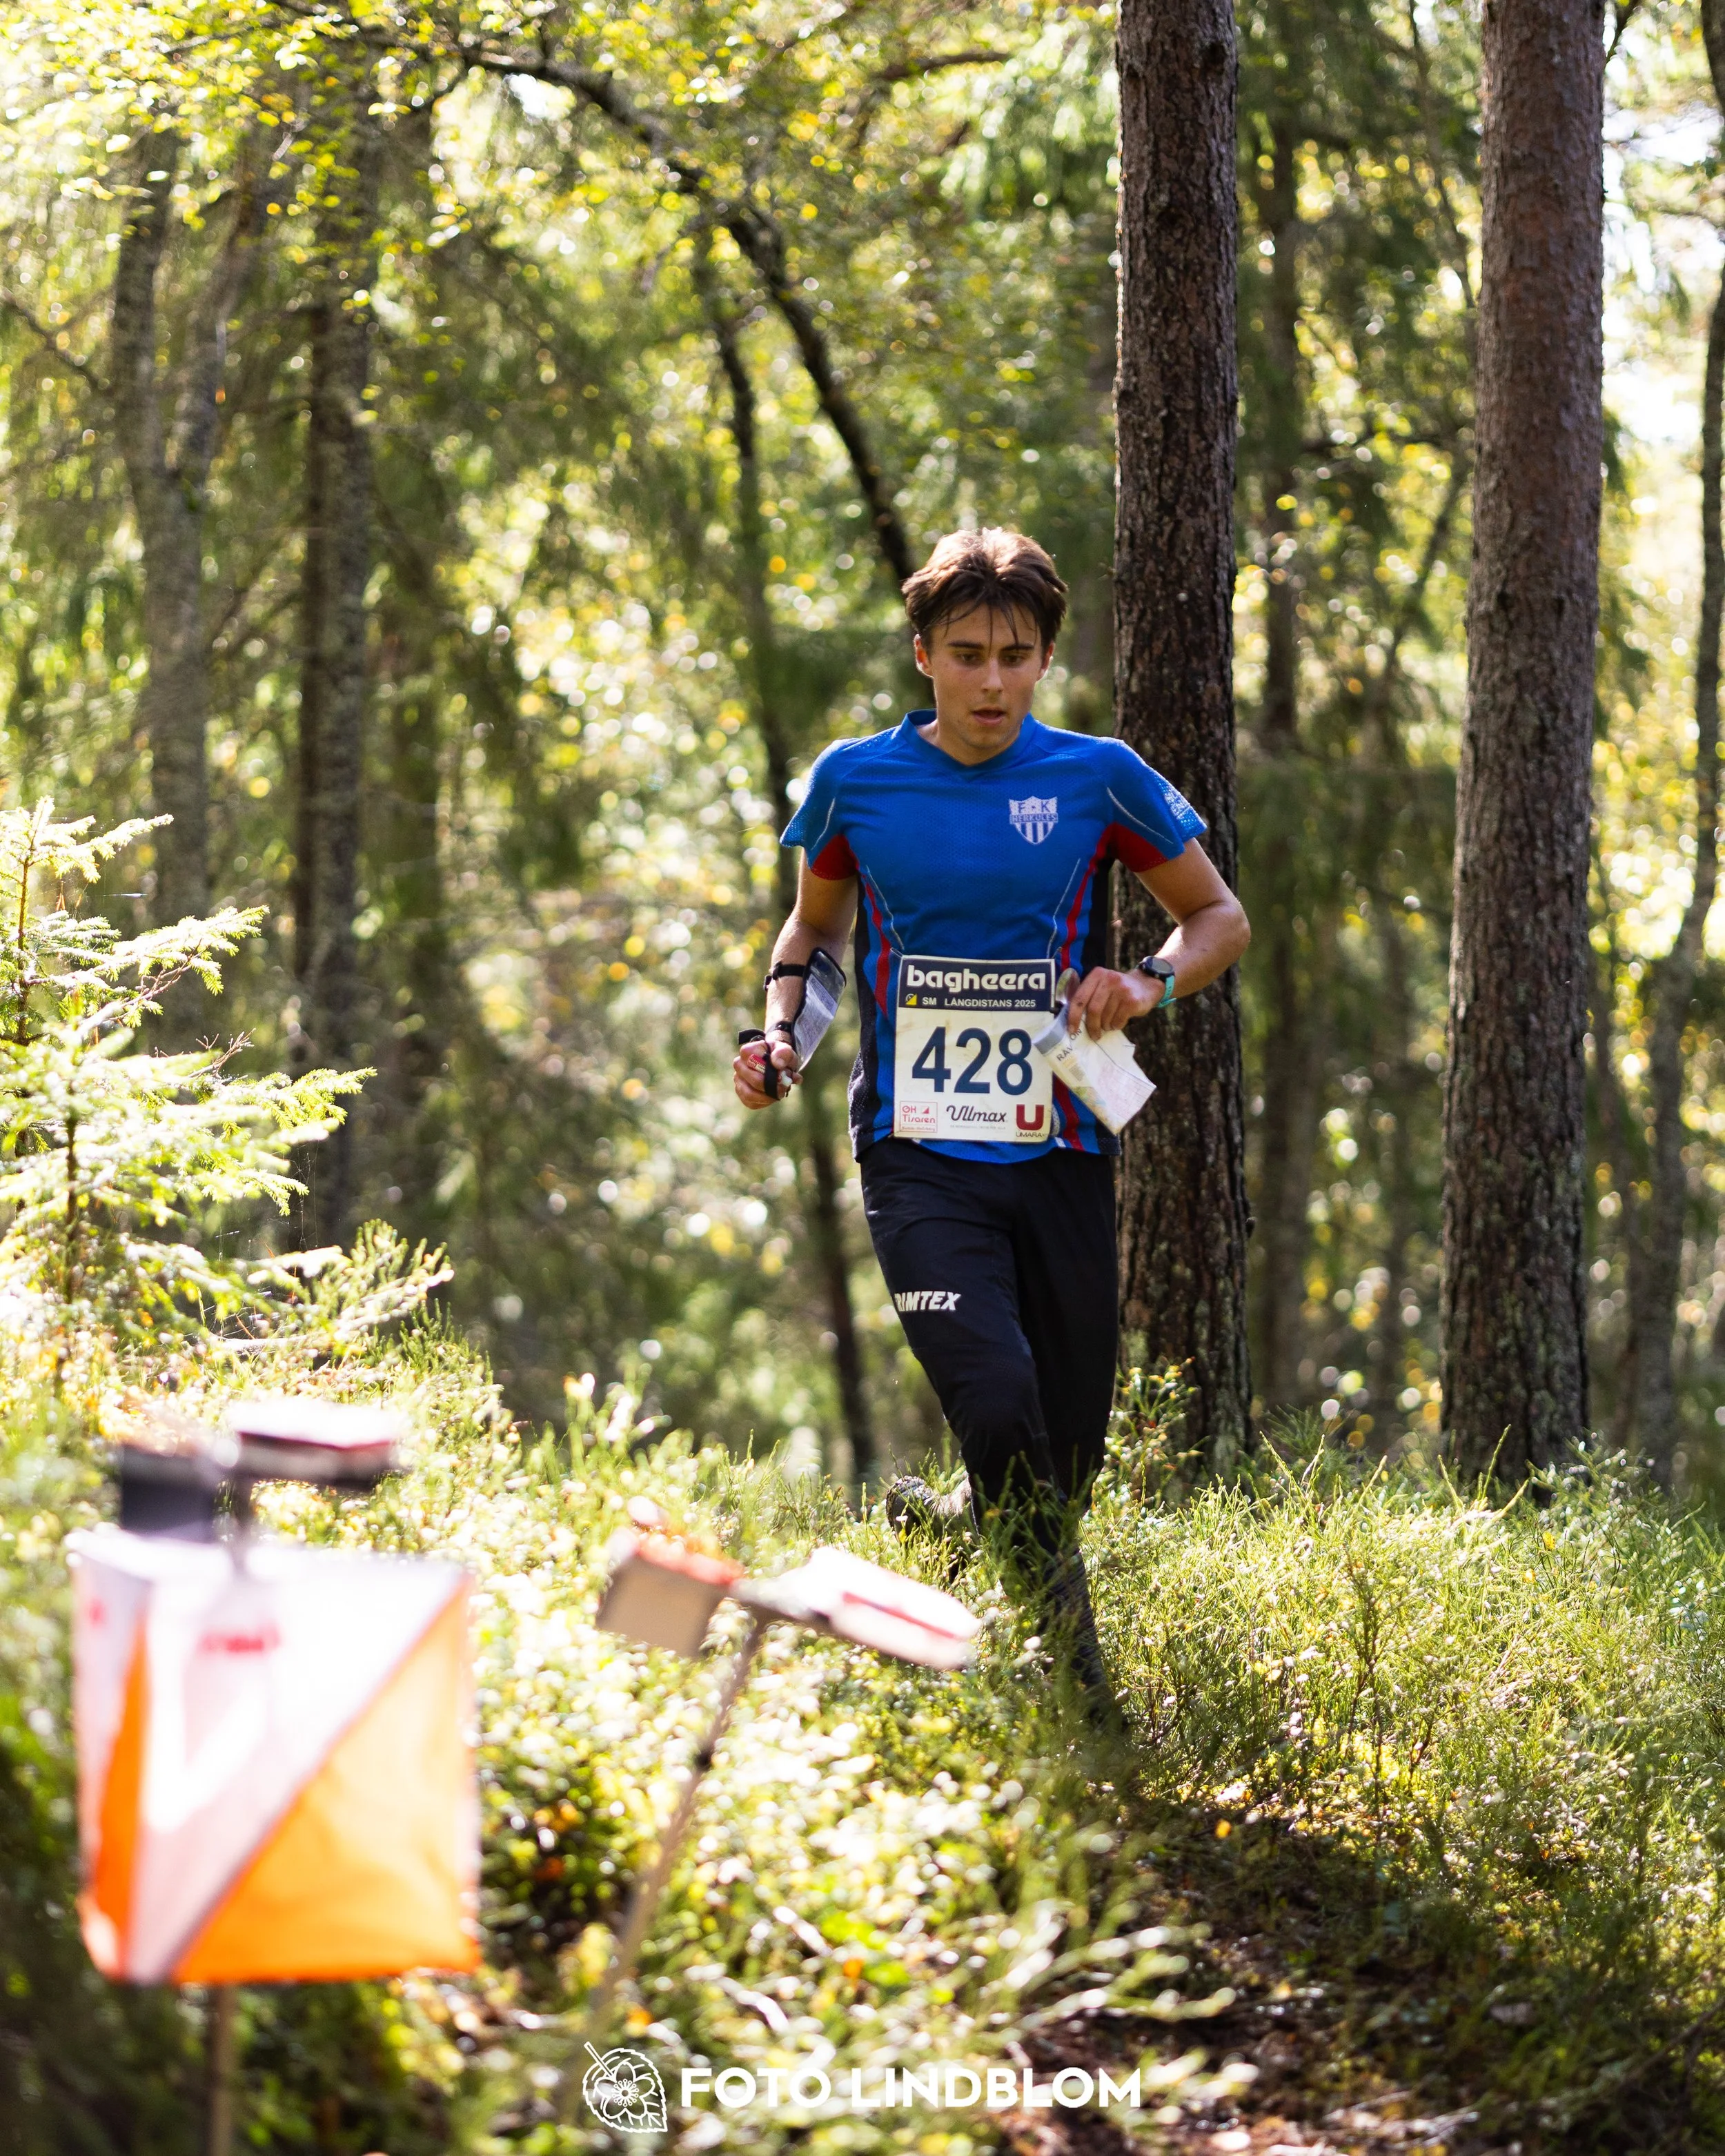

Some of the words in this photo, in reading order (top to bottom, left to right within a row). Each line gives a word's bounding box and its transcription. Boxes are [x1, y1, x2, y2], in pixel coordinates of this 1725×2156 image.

[1012, 814, 1057, 822] HERKULES
[907, 965, 1046, 993] bagheera
[922, 997, 937, 1005] SM
[945, 997, 1012, 1007] LÅNGDISTANS
[911, 1026, 1032, 1096] 428
[902, 1114, 936, 1123] Tisaren
[946, 1105, 1007, 1122] Ullmax
